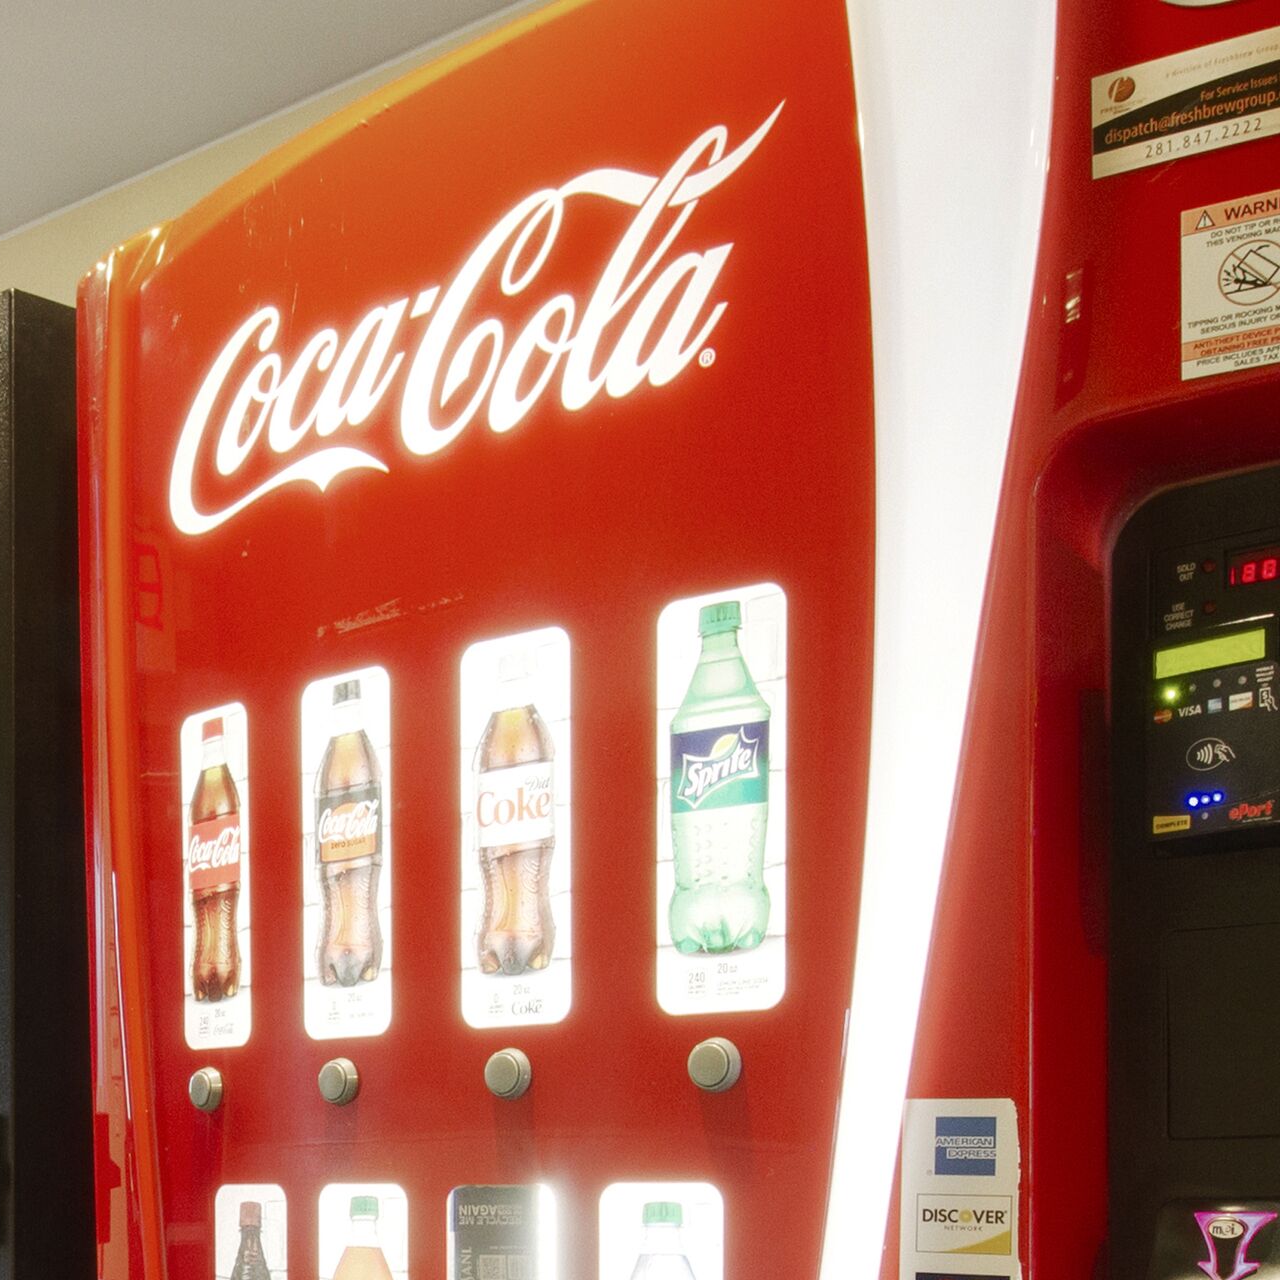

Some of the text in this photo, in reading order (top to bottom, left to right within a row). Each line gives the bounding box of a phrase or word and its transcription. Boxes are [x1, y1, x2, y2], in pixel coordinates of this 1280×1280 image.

[1200, 90, 1215, 102] For
[1217, 81, 1249, 97] Service
[1251, 74, 1278, 90] Issues
[1145, 117, 1263, 159] 281.847.2222
[1210, 231, 1223, 240] DO
[1224, 226, 1242, 236] NOT
[1244, 222, 1257, 231] TIP
[1258, 219, 1271, 228] OR
[1206, 239, 1224, 248] THIS
[1226, 229, 1263, 244] VENDING
[169, 97, 786, 536] Coca-Cola
[1188, 316, 1218, 329] TIPPING
[1220, 313, 1233, 322] OR
[1234, 305, 1273, 319] ROCKING
[1200, 322, 1236, 335] SERIOUS
[1238, 316, 1268, 329] INJURY
[1242, 328, 1271, 340] DEVICE
[1200, 343, 1246, 358] OBTAINING
[1247, 338, 1269, 349] FREE
[1196, 356, 1220, 367] PRICE
[1222, 349, 1264, 362] INCLUDES
[1233, 353, 1280, 368] SALES TAX
[1177, 562, 1196, 574] SOLD
[1179, 572, 1194, 582] OUT
[1164, 609, 1194, 622] CORRECT
[1172, 602, 1185, 612] USE
[1165, 619, 1192, 631] CHANGE
[1178, 704, 1202, 718] VISA
[685, 745, 754, 797] Sprite
[525, 776, 550, 791] Diet
[477, 787, 551, 828] Coke
[1228, 800, 1274, 821] ePort
[319, 799, 380, 843] Coca-Cola
[189, 826, 241, 872] Coca-Cola
[689, 972, 705, 984] 240
[935, 1137, 993, 1147] AMERICAN
[947, 1149, 997, 1159] EXPRESS
[458, 1204, 498, 1216] AGAIN
[922, 1208, 1006, 1224] DISCOVER
